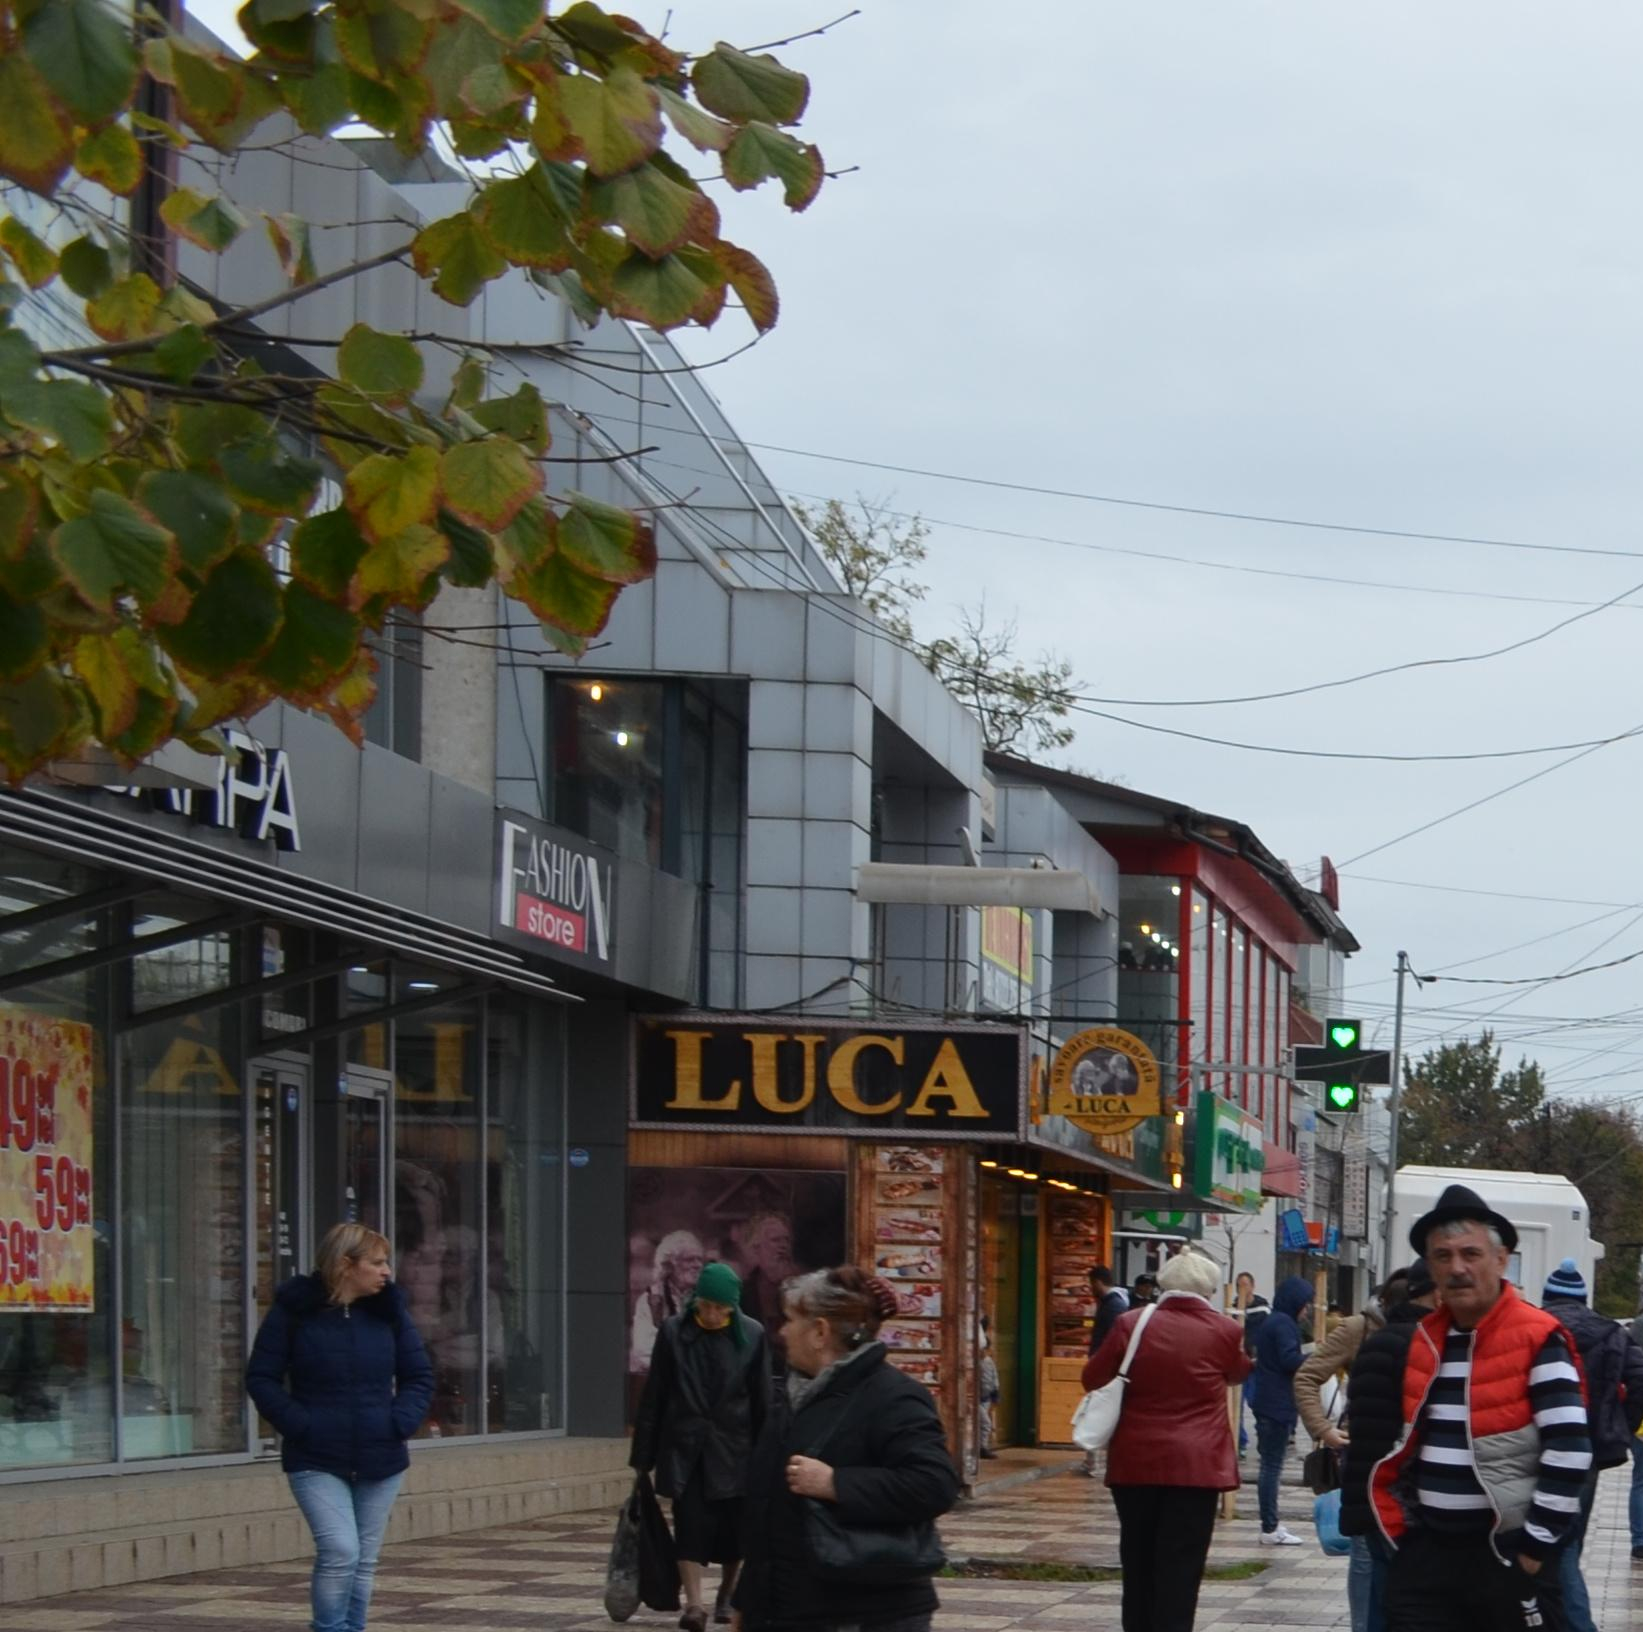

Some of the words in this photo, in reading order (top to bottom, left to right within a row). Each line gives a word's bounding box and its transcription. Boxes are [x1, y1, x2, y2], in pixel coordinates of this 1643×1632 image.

[500, 819, 612, 962] FASHION
[528, 902, 575, 947] store
[665, 1030, 990, 1118] LUCA
[1076, 1098, 1132, 1114] LUCA
[36, 1154, 75, 1232] 59
